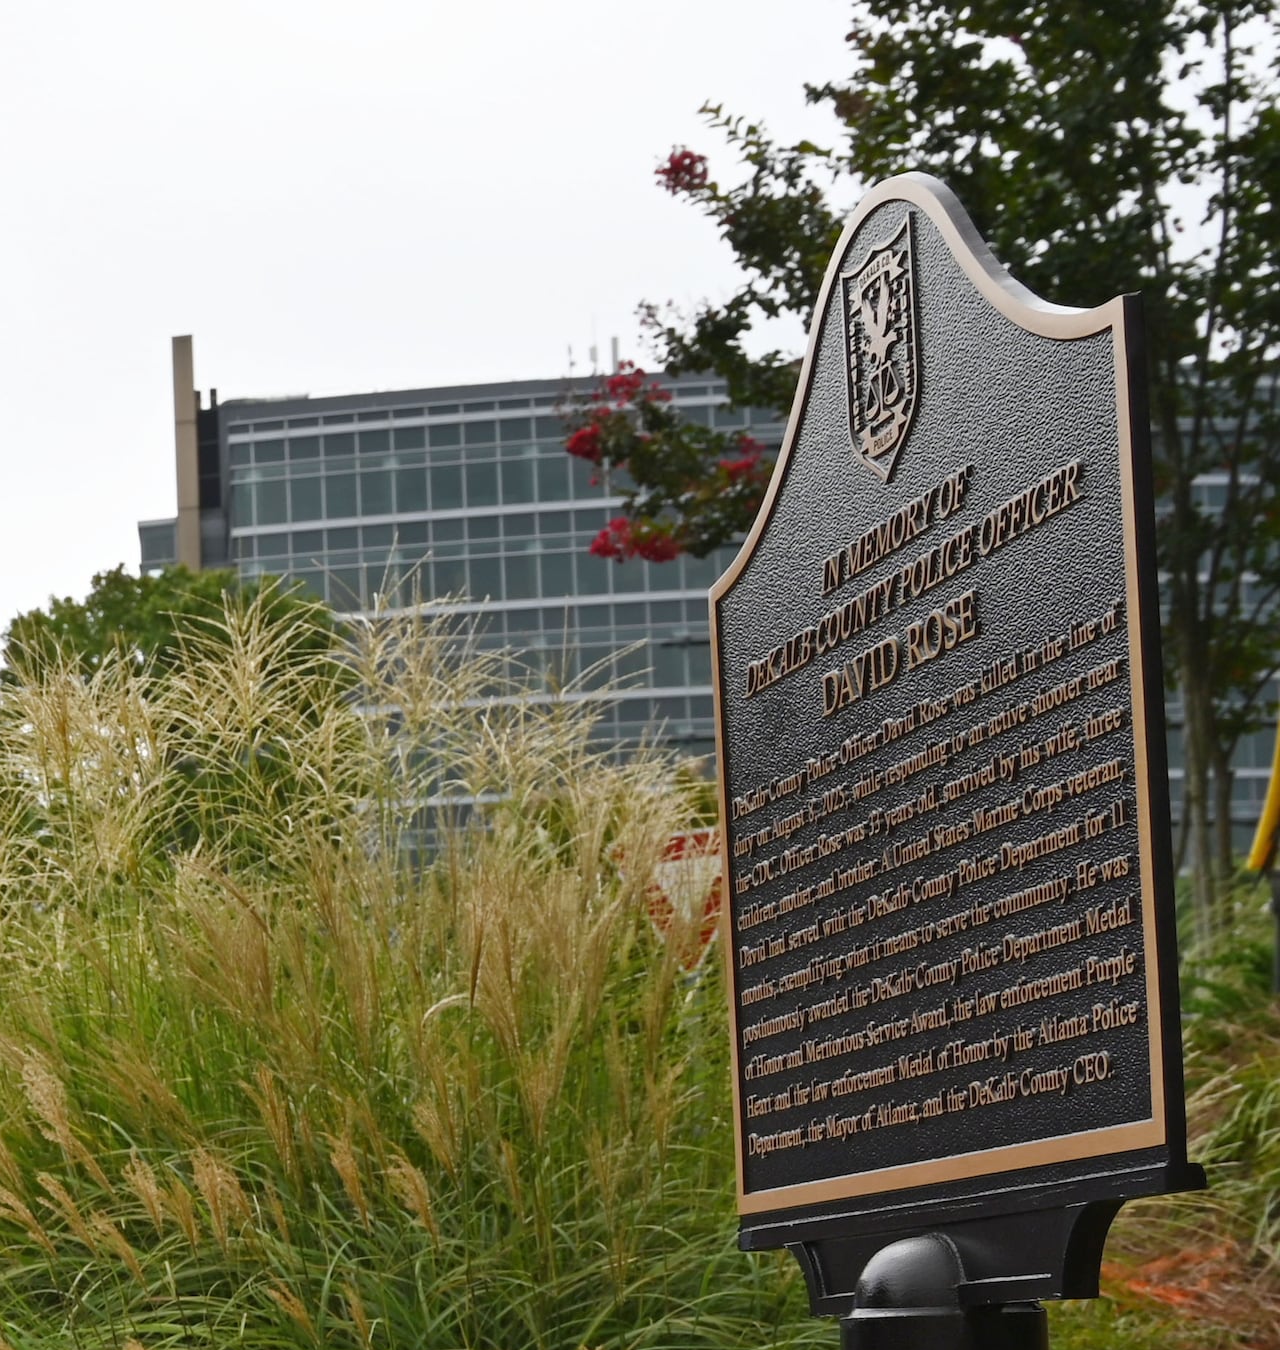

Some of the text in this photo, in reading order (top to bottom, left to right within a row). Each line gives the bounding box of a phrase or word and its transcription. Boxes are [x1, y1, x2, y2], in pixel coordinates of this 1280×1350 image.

[874, 428, 893, 452] POLICE
[817, 576, 893, 655] COUNTY
[899, 527, 972, 606] POLICE
[980, 461, 1078, 558] OFFICER
[821, 468, 966, 595] IN MEMORY OF
[732, 601, 1117, 820] DeKalb County Police Officer David Rose was killed in the line of
[820, 592, 974, 719] DAVID ROSE
[733, 833, 752, 858] duty
[756, 828, 768, 847] on
[771, 806, 804, 840] August
[808, 799, 817, 825] 8,
[852, 770, 880, 801] while
[885, 742, 947, 786] responding
[951, 732, 963, 755] to
[968, 724, 983, 747] an
[988, 704, 1025, 738] active
[1031, 677, 1081, 718] shooter
[1088, 659, 1118, 691] near
[735, 871, 749, 894] the
[780, 846, 813, 875] Officer
[817, 833, 842, 858] Rose
[846, 823, 864, 846] was
[868, 810, 879, 836] 33
[885, 801, 913, 836] years
[943, 757, 994, 803] survived
[999, 751, 1015, 784] by
[1020, 742, 1039, 770] his
[1045, 724, 1079, 759] wife,
[1085, 708, 1120, 741] three
[738, 903, 777, 931] children,
[779, 885, 815, 914] mother,
[817, 871, 834, 899] and
[880, 847, 891, 873] A
[893, 831, 929, 868] United
[934, 822, 968, 852] States
[972, 801, 1018, 836] Marine
[1022, 783, 1062, 816] Corps
[1068, 759, 1124, 798] veteran,
[739, 799, 1125, 968] David had served with the DeKalb County Police Department for 11
[741, 856, 1128, 1006] months, exemplifying what it means to serve the community. He was
[743, 897, 1131, 1049] posthumously awarded the DeKalb County Police Department Medal
[745, 949, 1134, 1080] of Honor and Meritorious Service Award, the law enforcement Purple
[747, 1002, 1137, 1117] Heart and the law enforcement Medal of Honor by the Atlanta Police
[748, 1053, 1112, 1158] Department, the Mayor of Atlanta, and the DeKalb County CEO.
